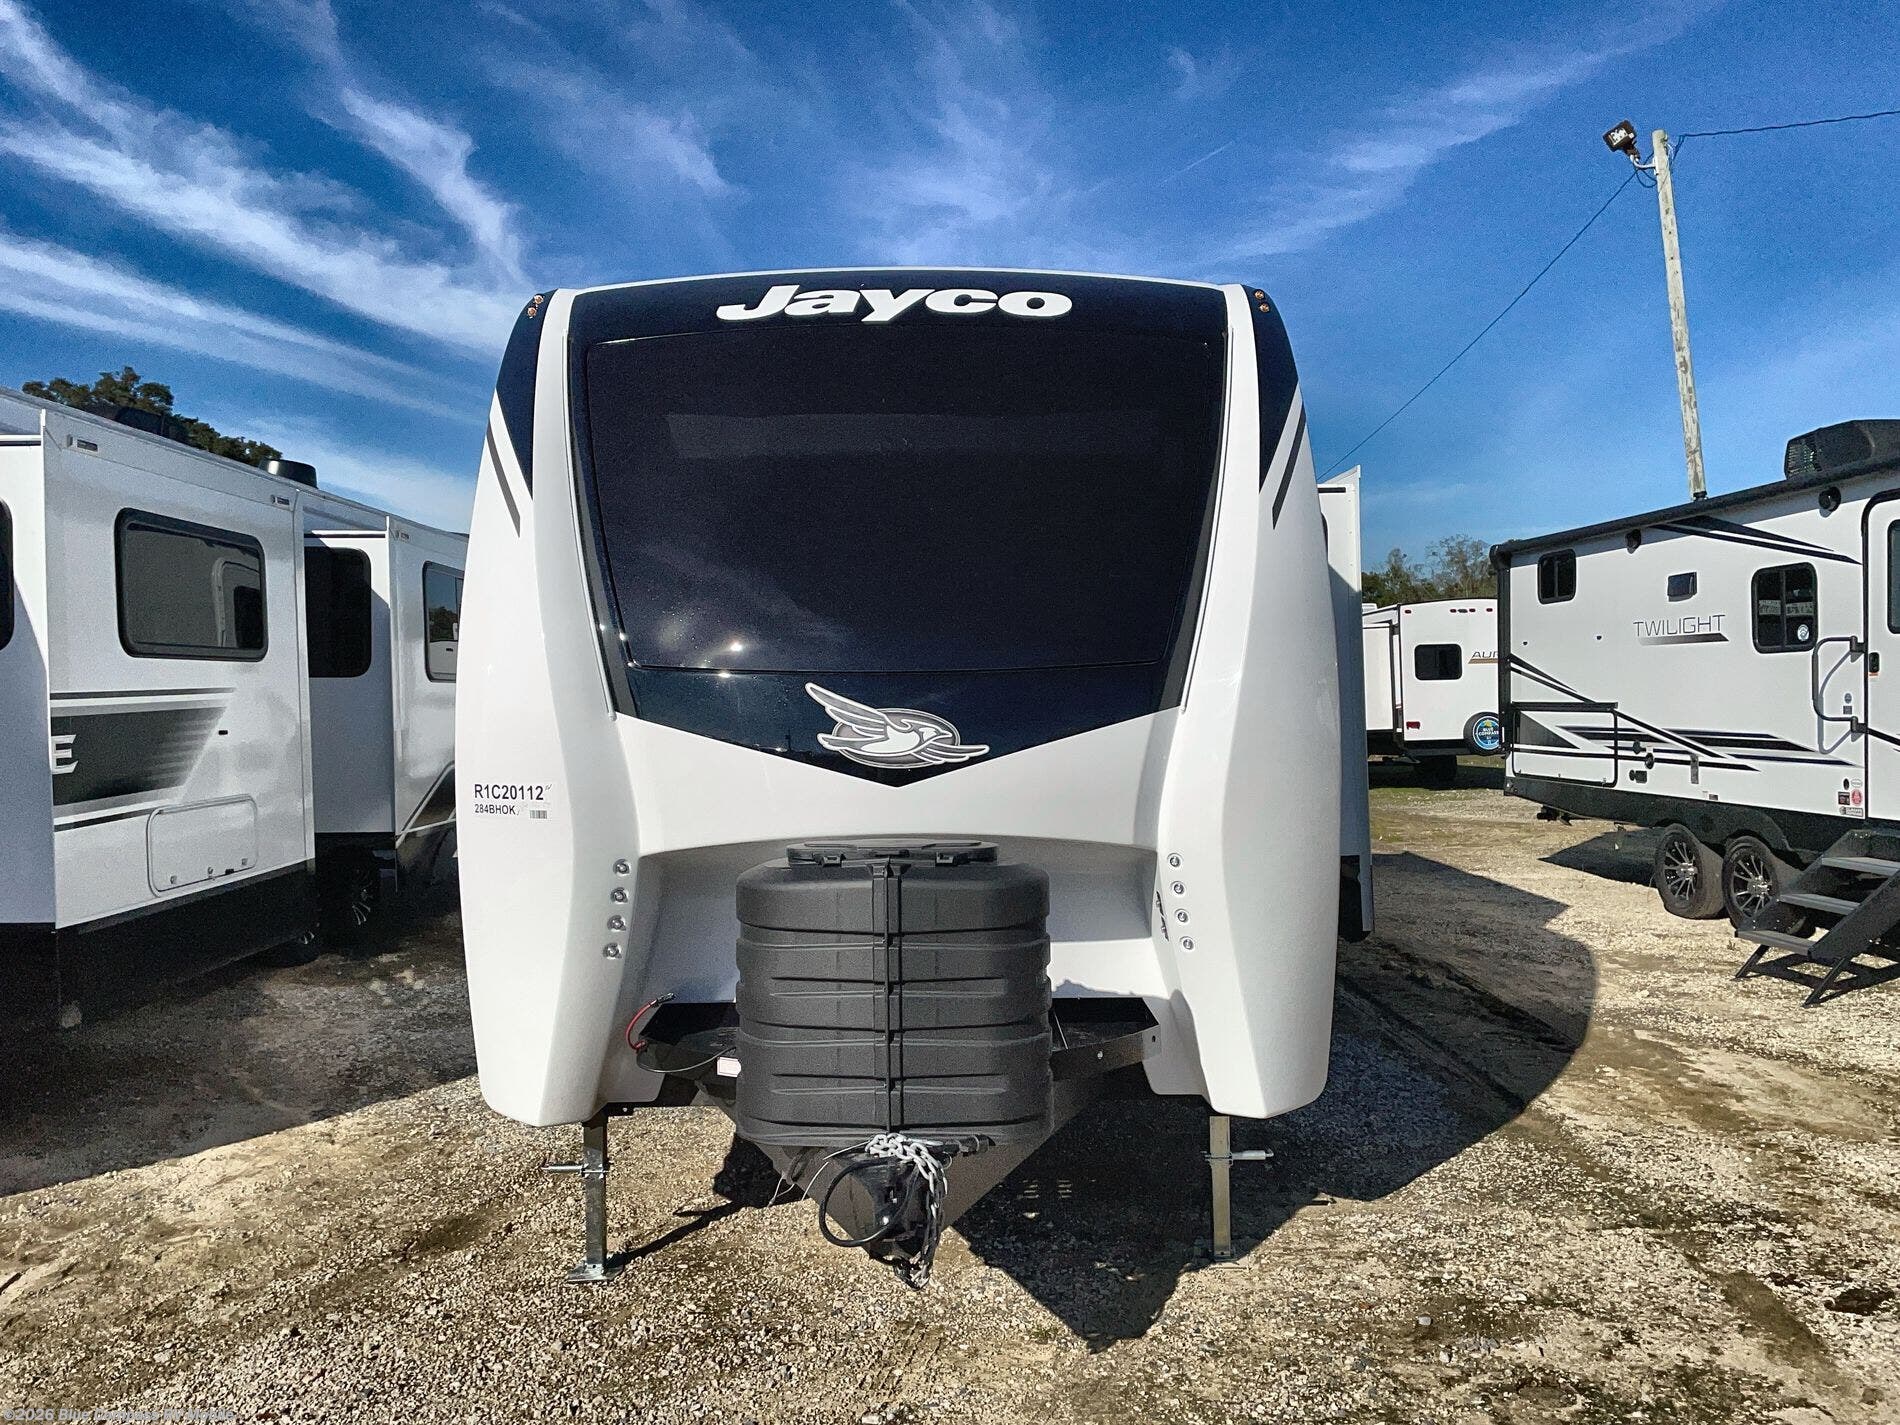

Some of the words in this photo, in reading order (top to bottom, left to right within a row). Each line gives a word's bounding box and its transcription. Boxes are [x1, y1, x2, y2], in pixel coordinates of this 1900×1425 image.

[716, 285, 1073, 322] Jayco
[1632, 614, 1726, 637] TWILIGHT
[474, 784, 544, 800] R1C20112
[474, 804, 516, 815] 284BHOK
